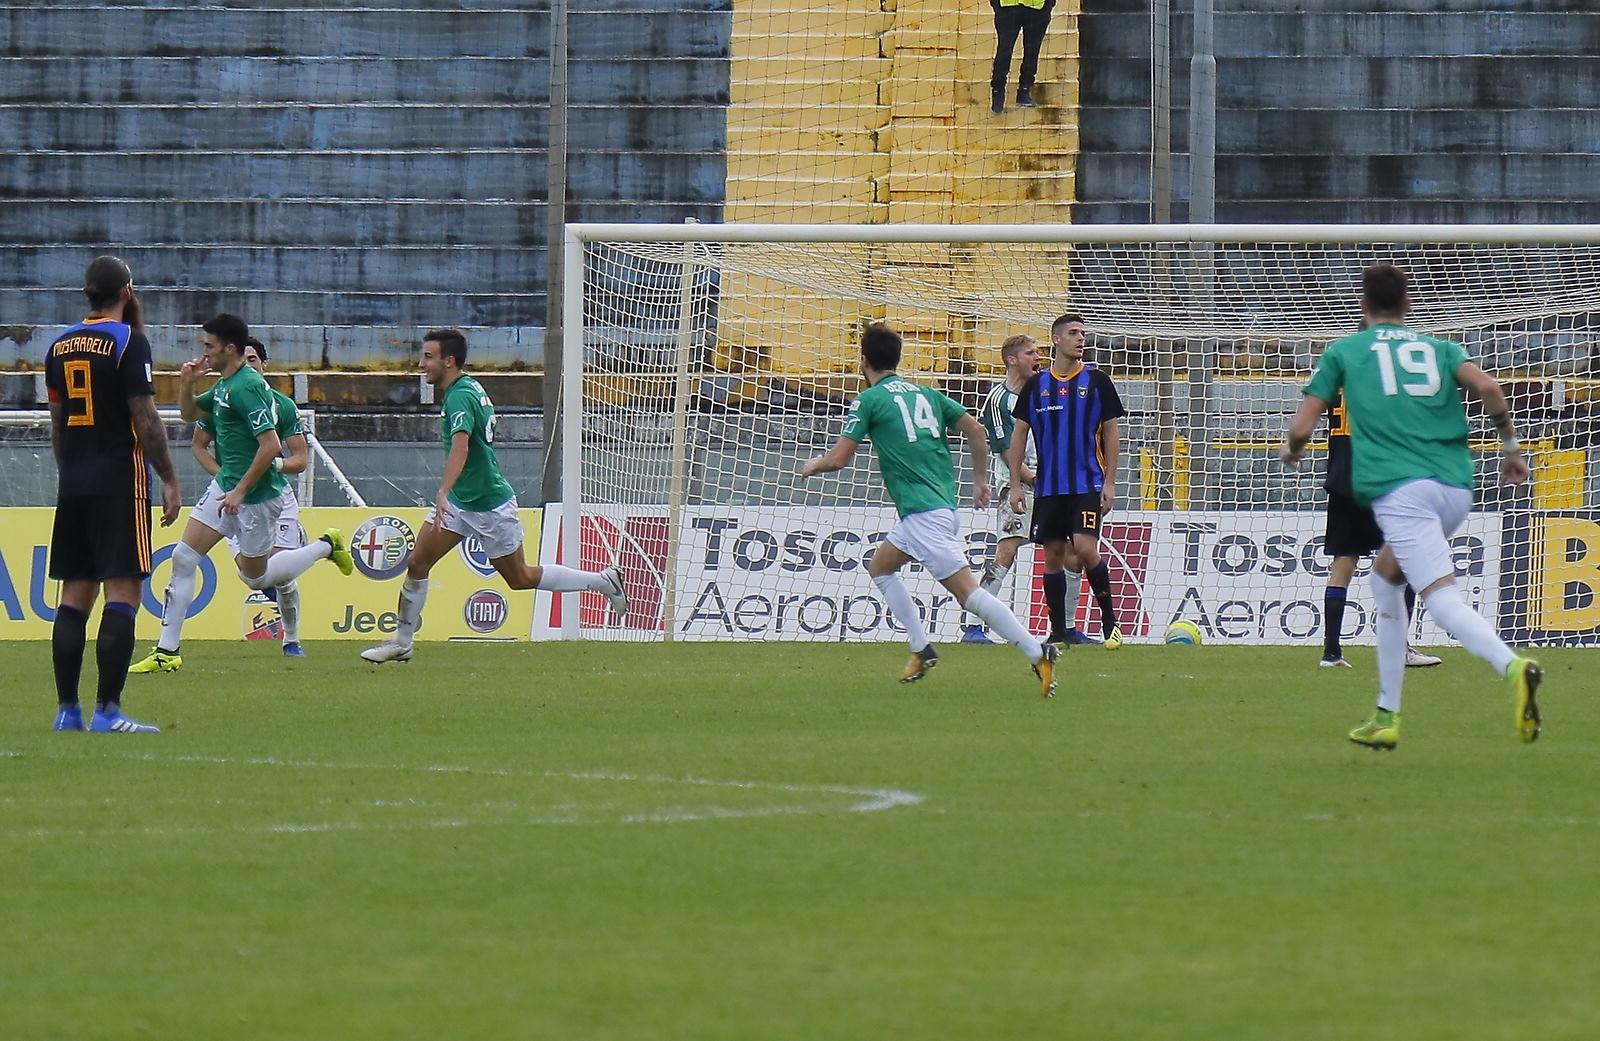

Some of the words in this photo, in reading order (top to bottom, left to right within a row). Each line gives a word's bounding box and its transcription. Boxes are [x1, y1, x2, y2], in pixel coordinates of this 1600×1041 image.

[53, 336, 114, 357] MOSCARDELLI
[1370, 342, 1441, 397] 19
[63, 360, 95, 427] 9
[893, 393, 940, 443] 14
[352, 520, 377, 550] ALF
[382, 517, 416, 551] ROMEO
[691, 517, 998, 573] Tosca
[1081, 510, 1097, 529] 13
[1169, 521, 1485, 578] Tosca
[0, 543, 217, 622] UO
[332, 604, 423, 633] Jee
[473, 602, 500, 622] FIAT
[681, 581, 990, 642] Aeropor
[1169, 586, 1481, 641] Aerori
